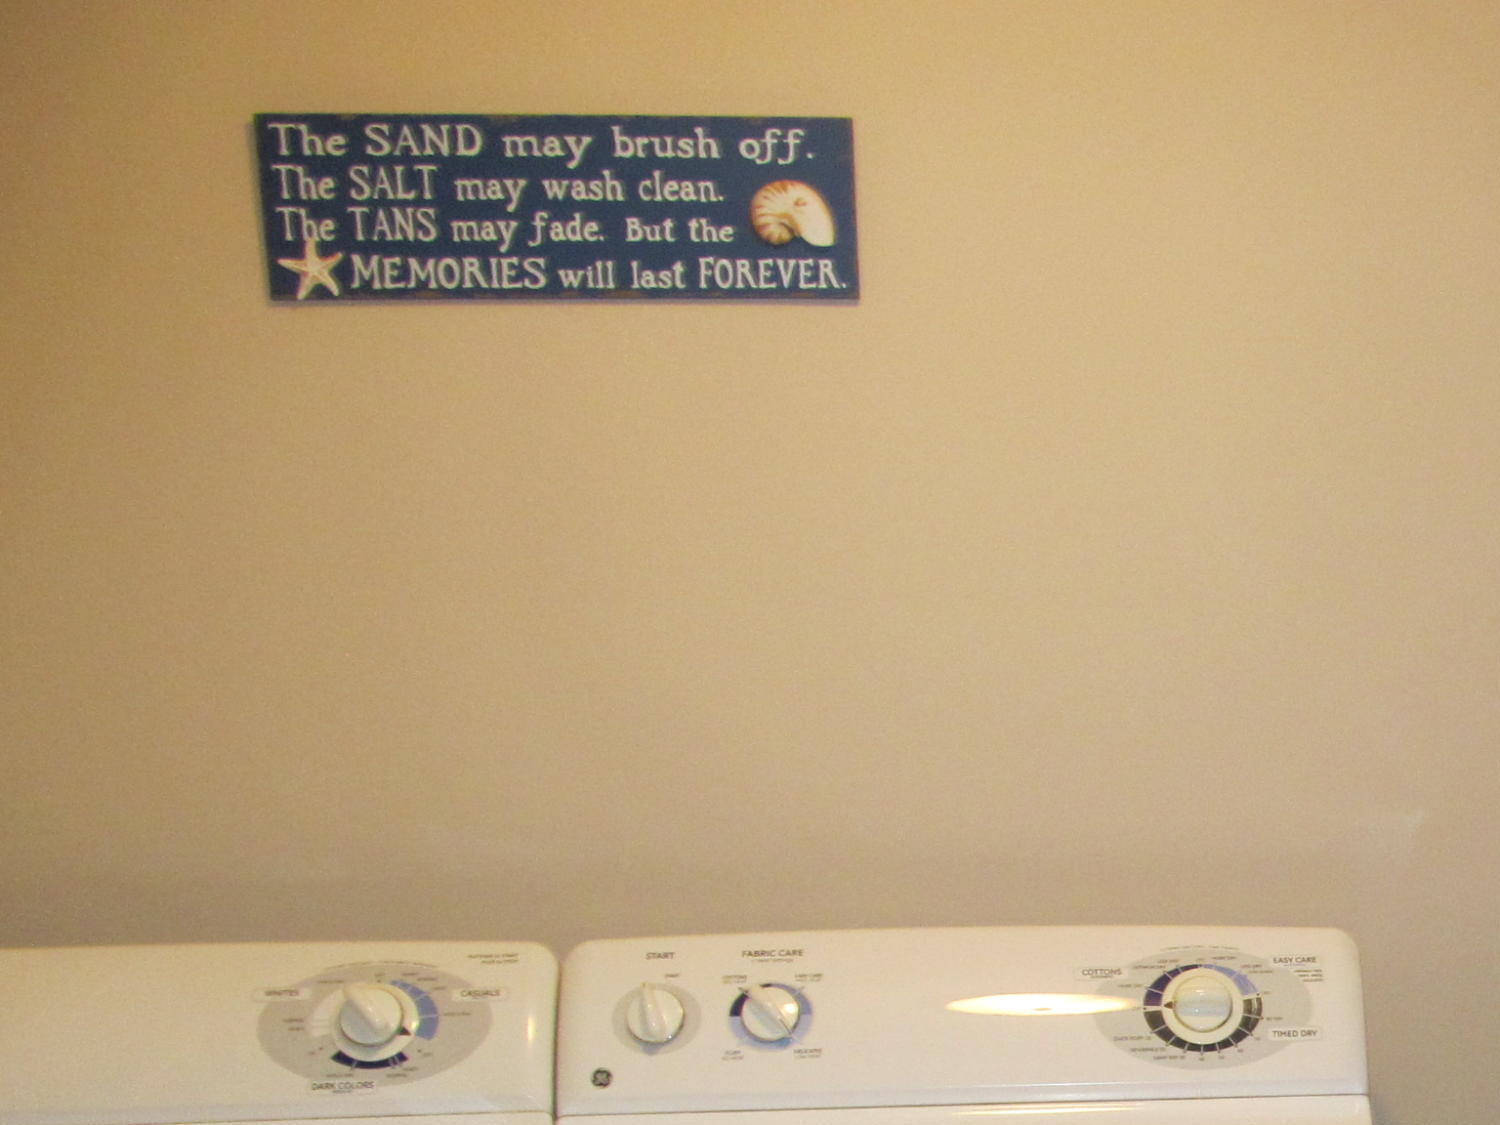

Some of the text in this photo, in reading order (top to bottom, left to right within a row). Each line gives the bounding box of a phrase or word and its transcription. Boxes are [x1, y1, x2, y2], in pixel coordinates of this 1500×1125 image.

[268, 123, 815, 168] The SAND may brush off.
[271, 164, 724, 212] The SALT may wash clean.
[275, 206, 735, 253] The TANS may fade. But the
[350, 254, 848, 290] MEMORIES will last FOREVER.
[1082, 968, 1122, 976] COTTONS
